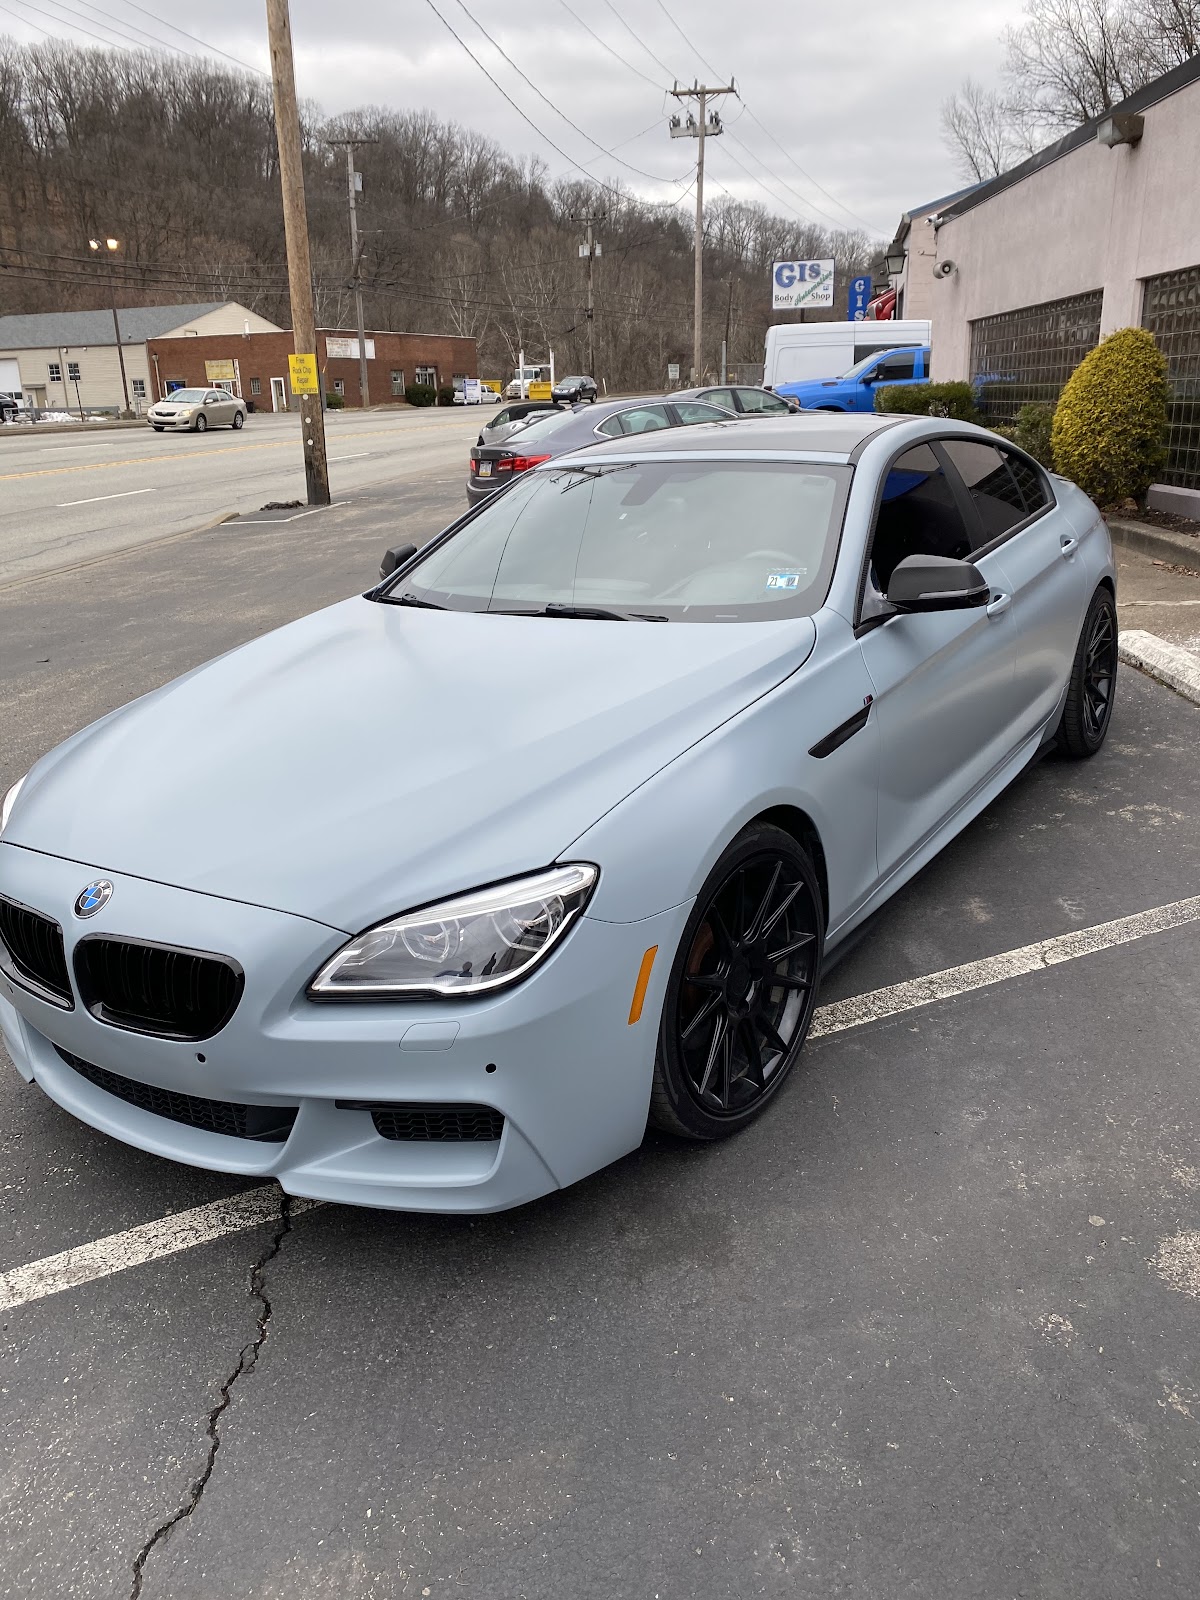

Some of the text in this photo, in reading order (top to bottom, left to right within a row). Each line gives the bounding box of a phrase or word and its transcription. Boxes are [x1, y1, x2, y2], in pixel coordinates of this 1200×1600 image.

[775, 263, 822, 288] GIS
[774, 294, 794, 303] Body
[811, 292, 831, 301] Shop
[295, 356, 305, 365] Free
[292, 366, 312, 375] Rock Chip
[296, 376, 310, 386] Repair
[769, 576, 778, 587] 21
